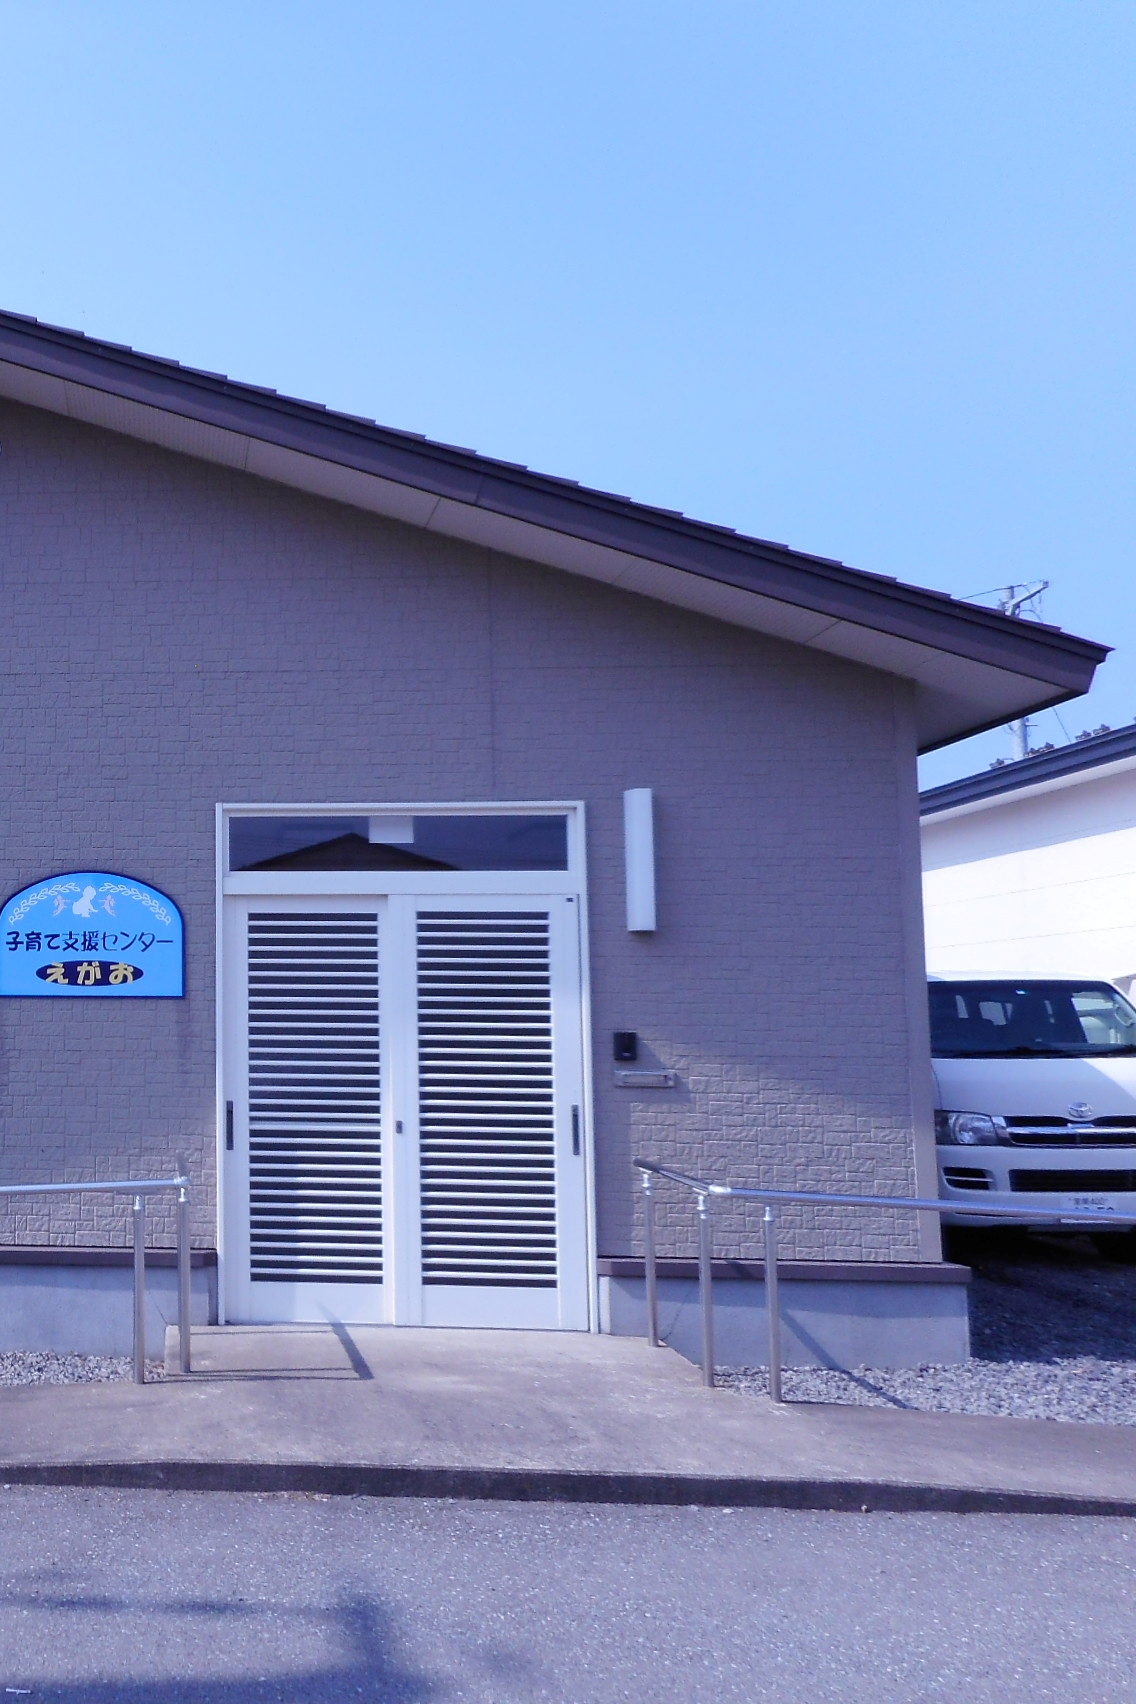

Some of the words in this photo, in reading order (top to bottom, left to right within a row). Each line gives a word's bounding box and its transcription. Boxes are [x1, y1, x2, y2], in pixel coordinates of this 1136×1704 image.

[5, 930, 174, 952] 子育て支援センター
[45, 960, 135, 986] えがお
